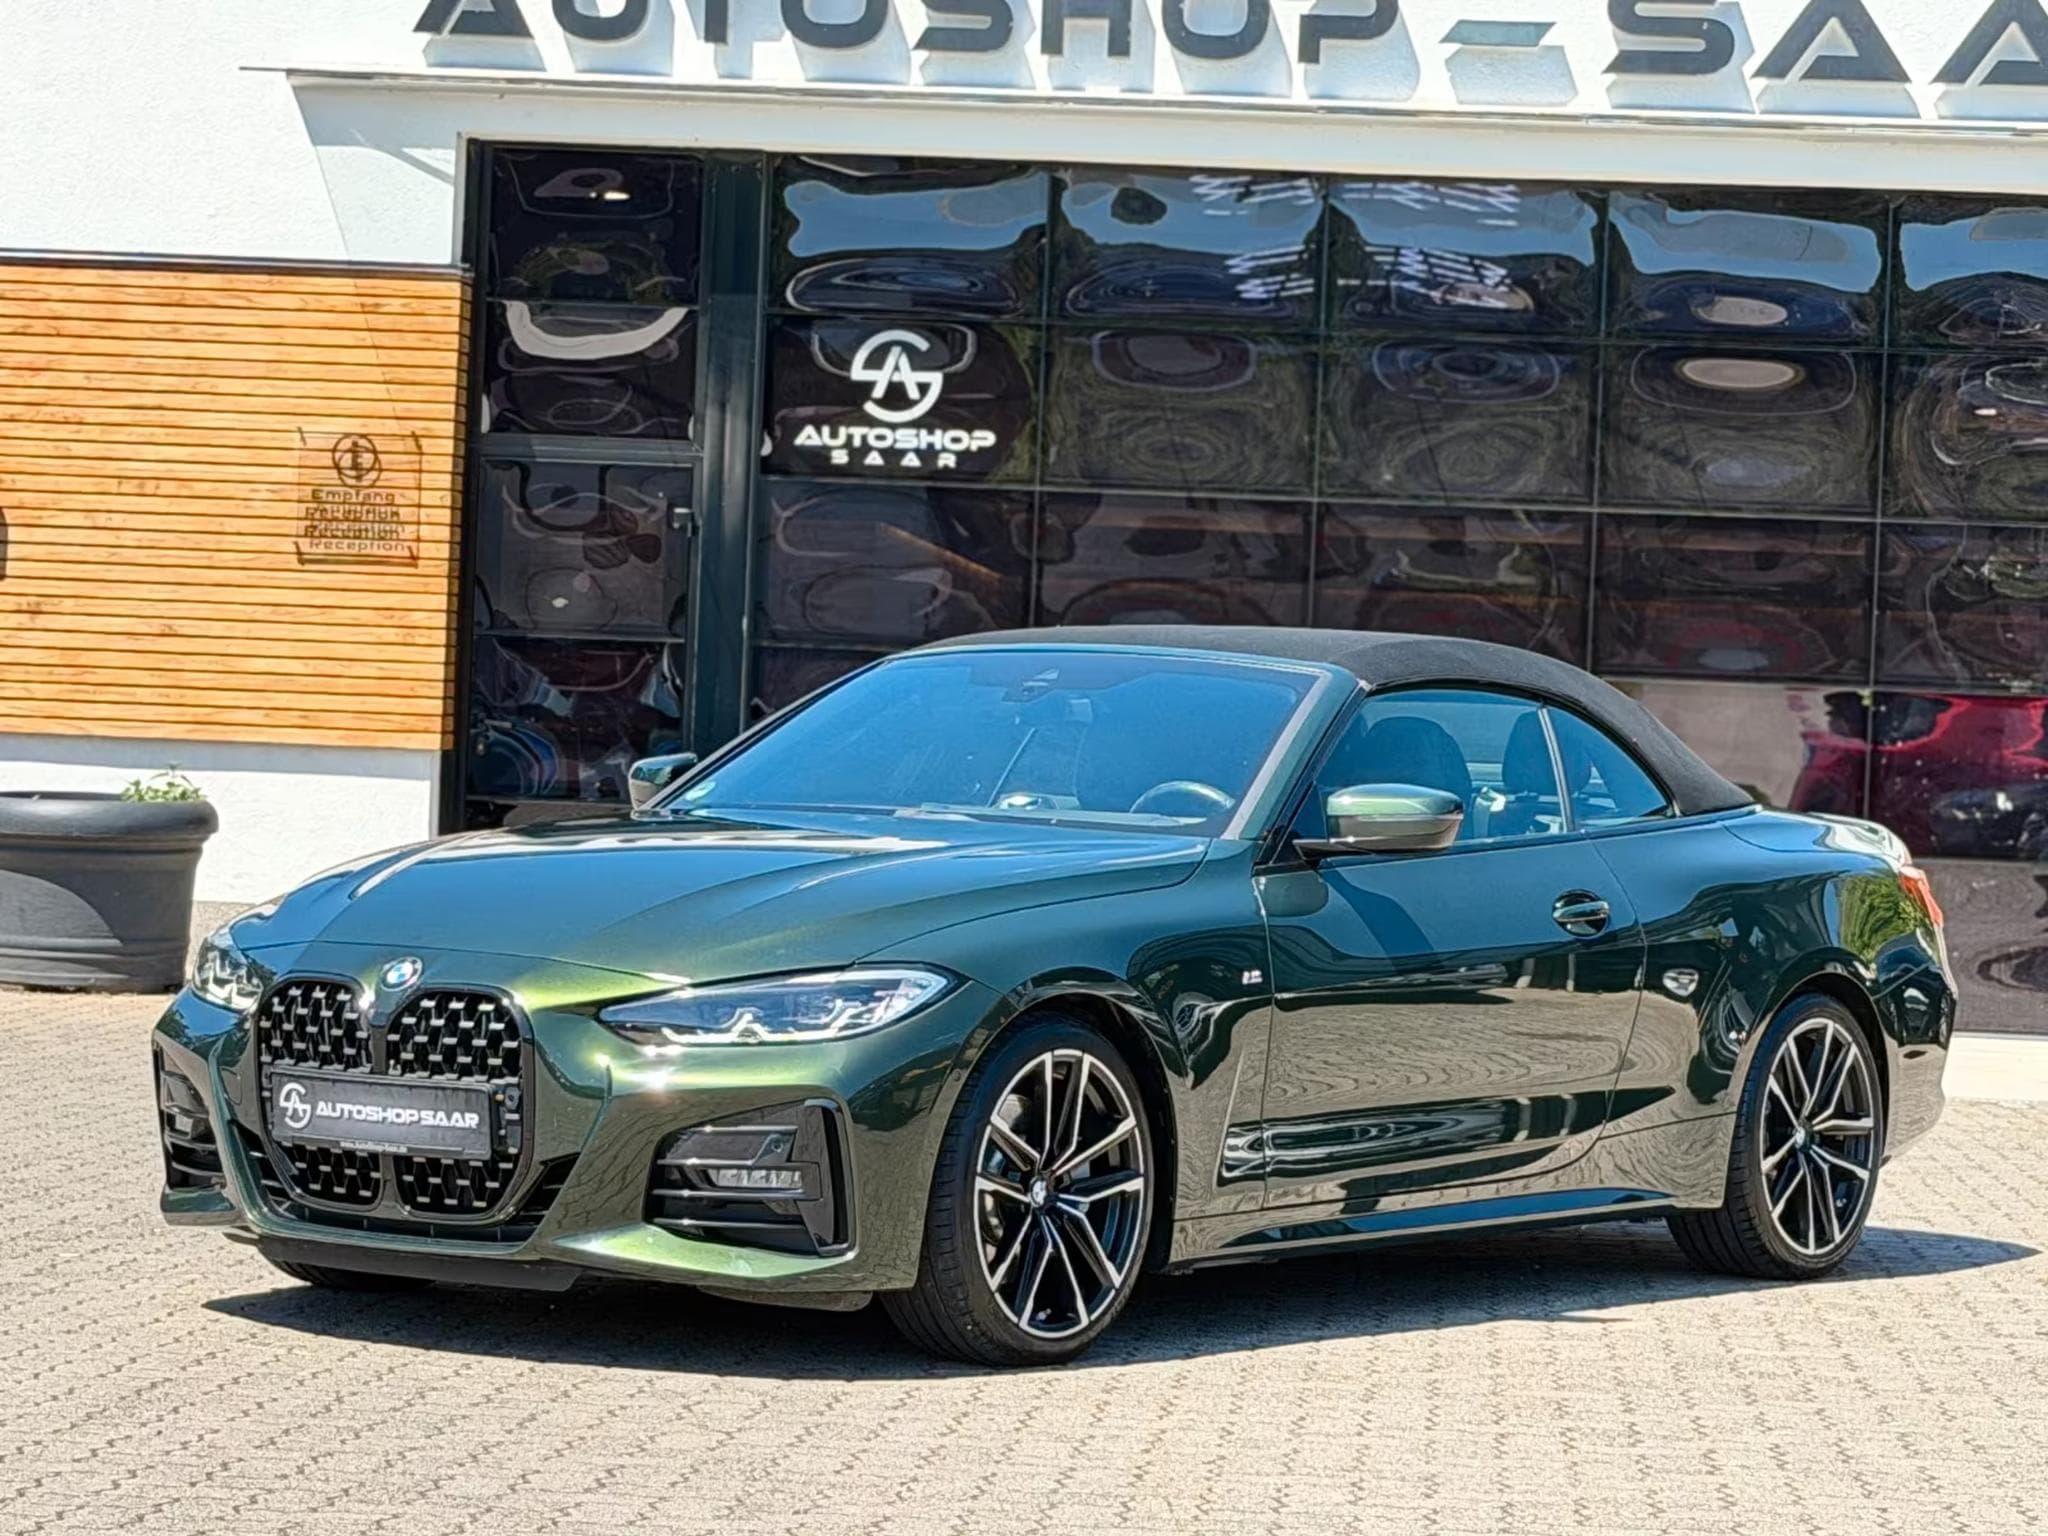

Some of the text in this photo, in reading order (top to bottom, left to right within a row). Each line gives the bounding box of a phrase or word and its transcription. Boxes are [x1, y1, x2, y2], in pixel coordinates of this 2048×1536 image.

[793, 424, 997, 451] AUTOSHOP
[830, 449, 957, 468] SAAR
[311, 488, 396, 504] Empfang
